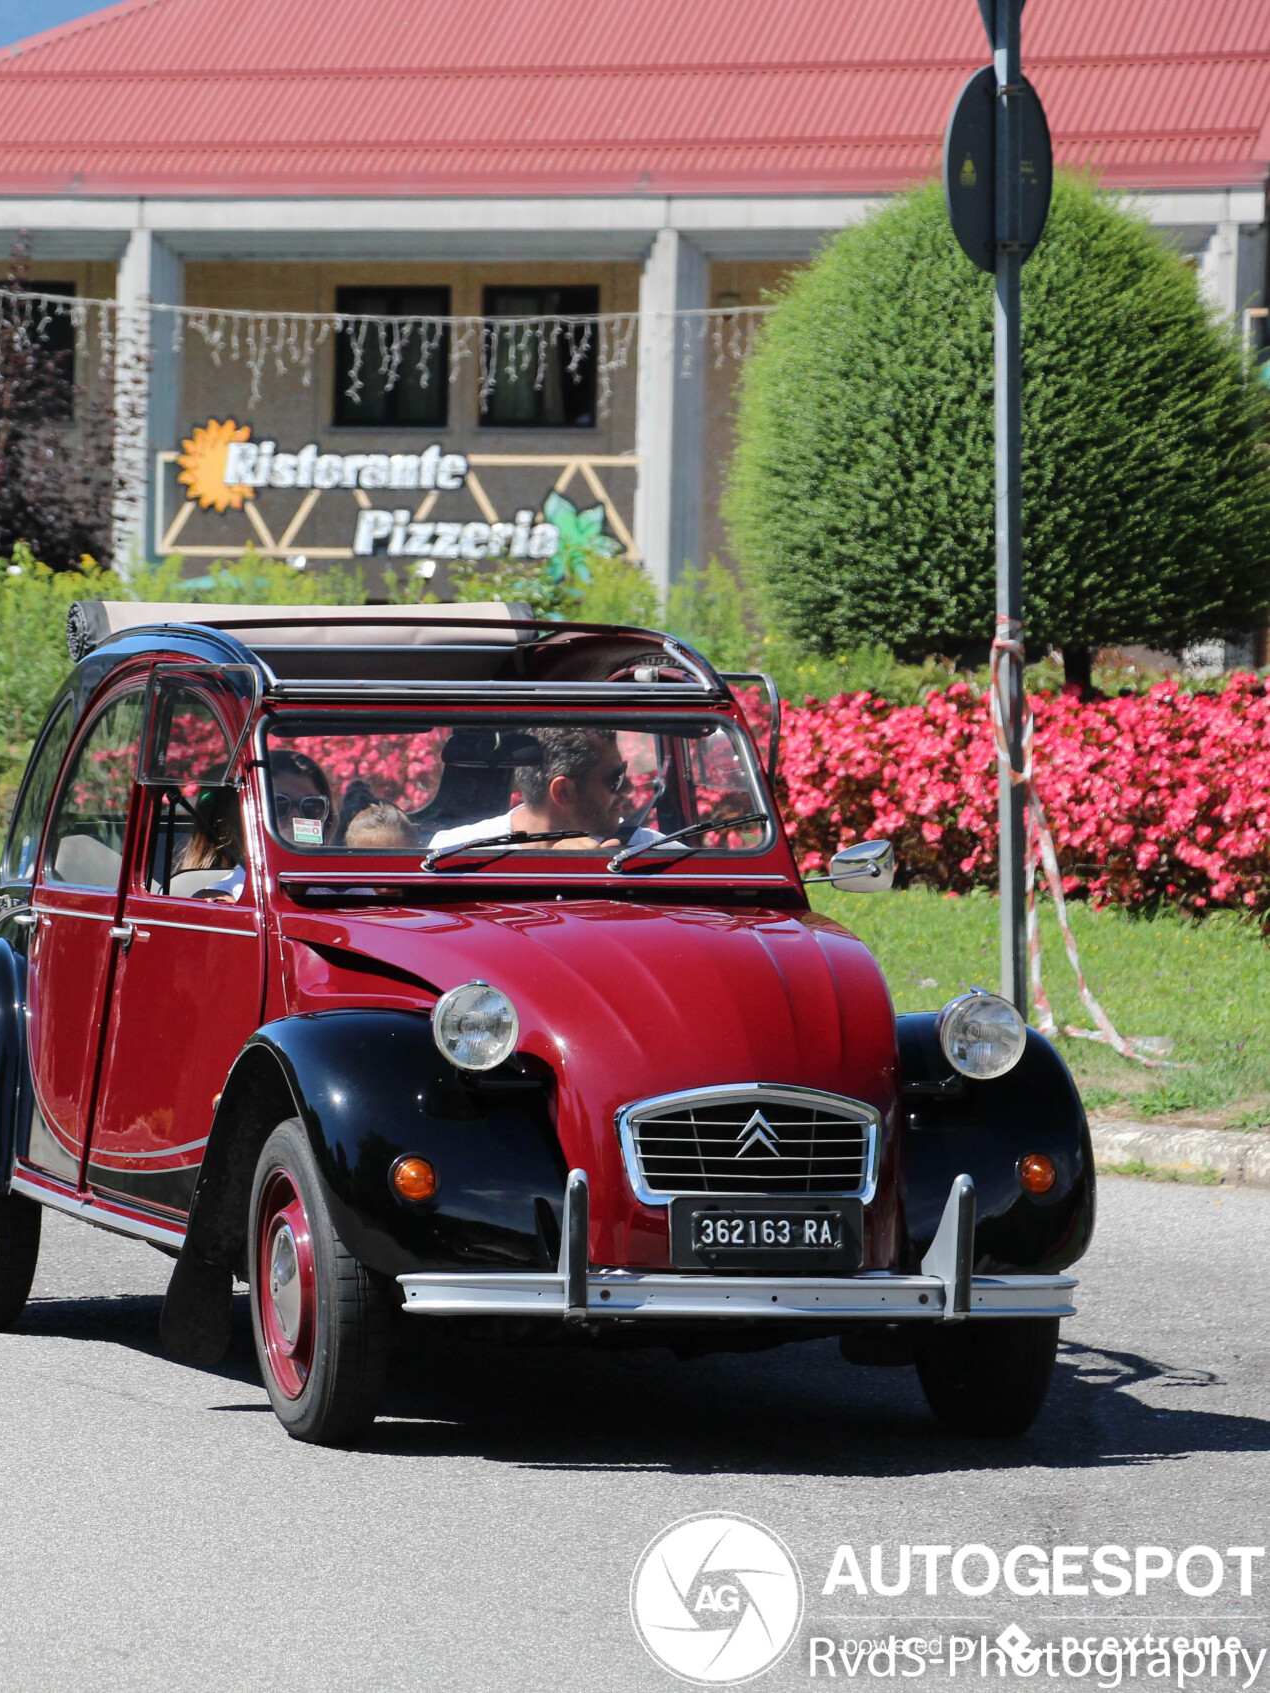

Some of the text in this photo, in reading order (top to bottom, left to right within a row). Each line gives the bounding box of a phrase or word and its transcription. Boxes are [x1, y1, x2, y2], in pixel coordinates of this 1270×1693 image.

[223, 441, 468, 490] Ristorante
[353, 509, 560, 559] Pizzeria
[701, 1220, 832, 1244] 362163 RA
